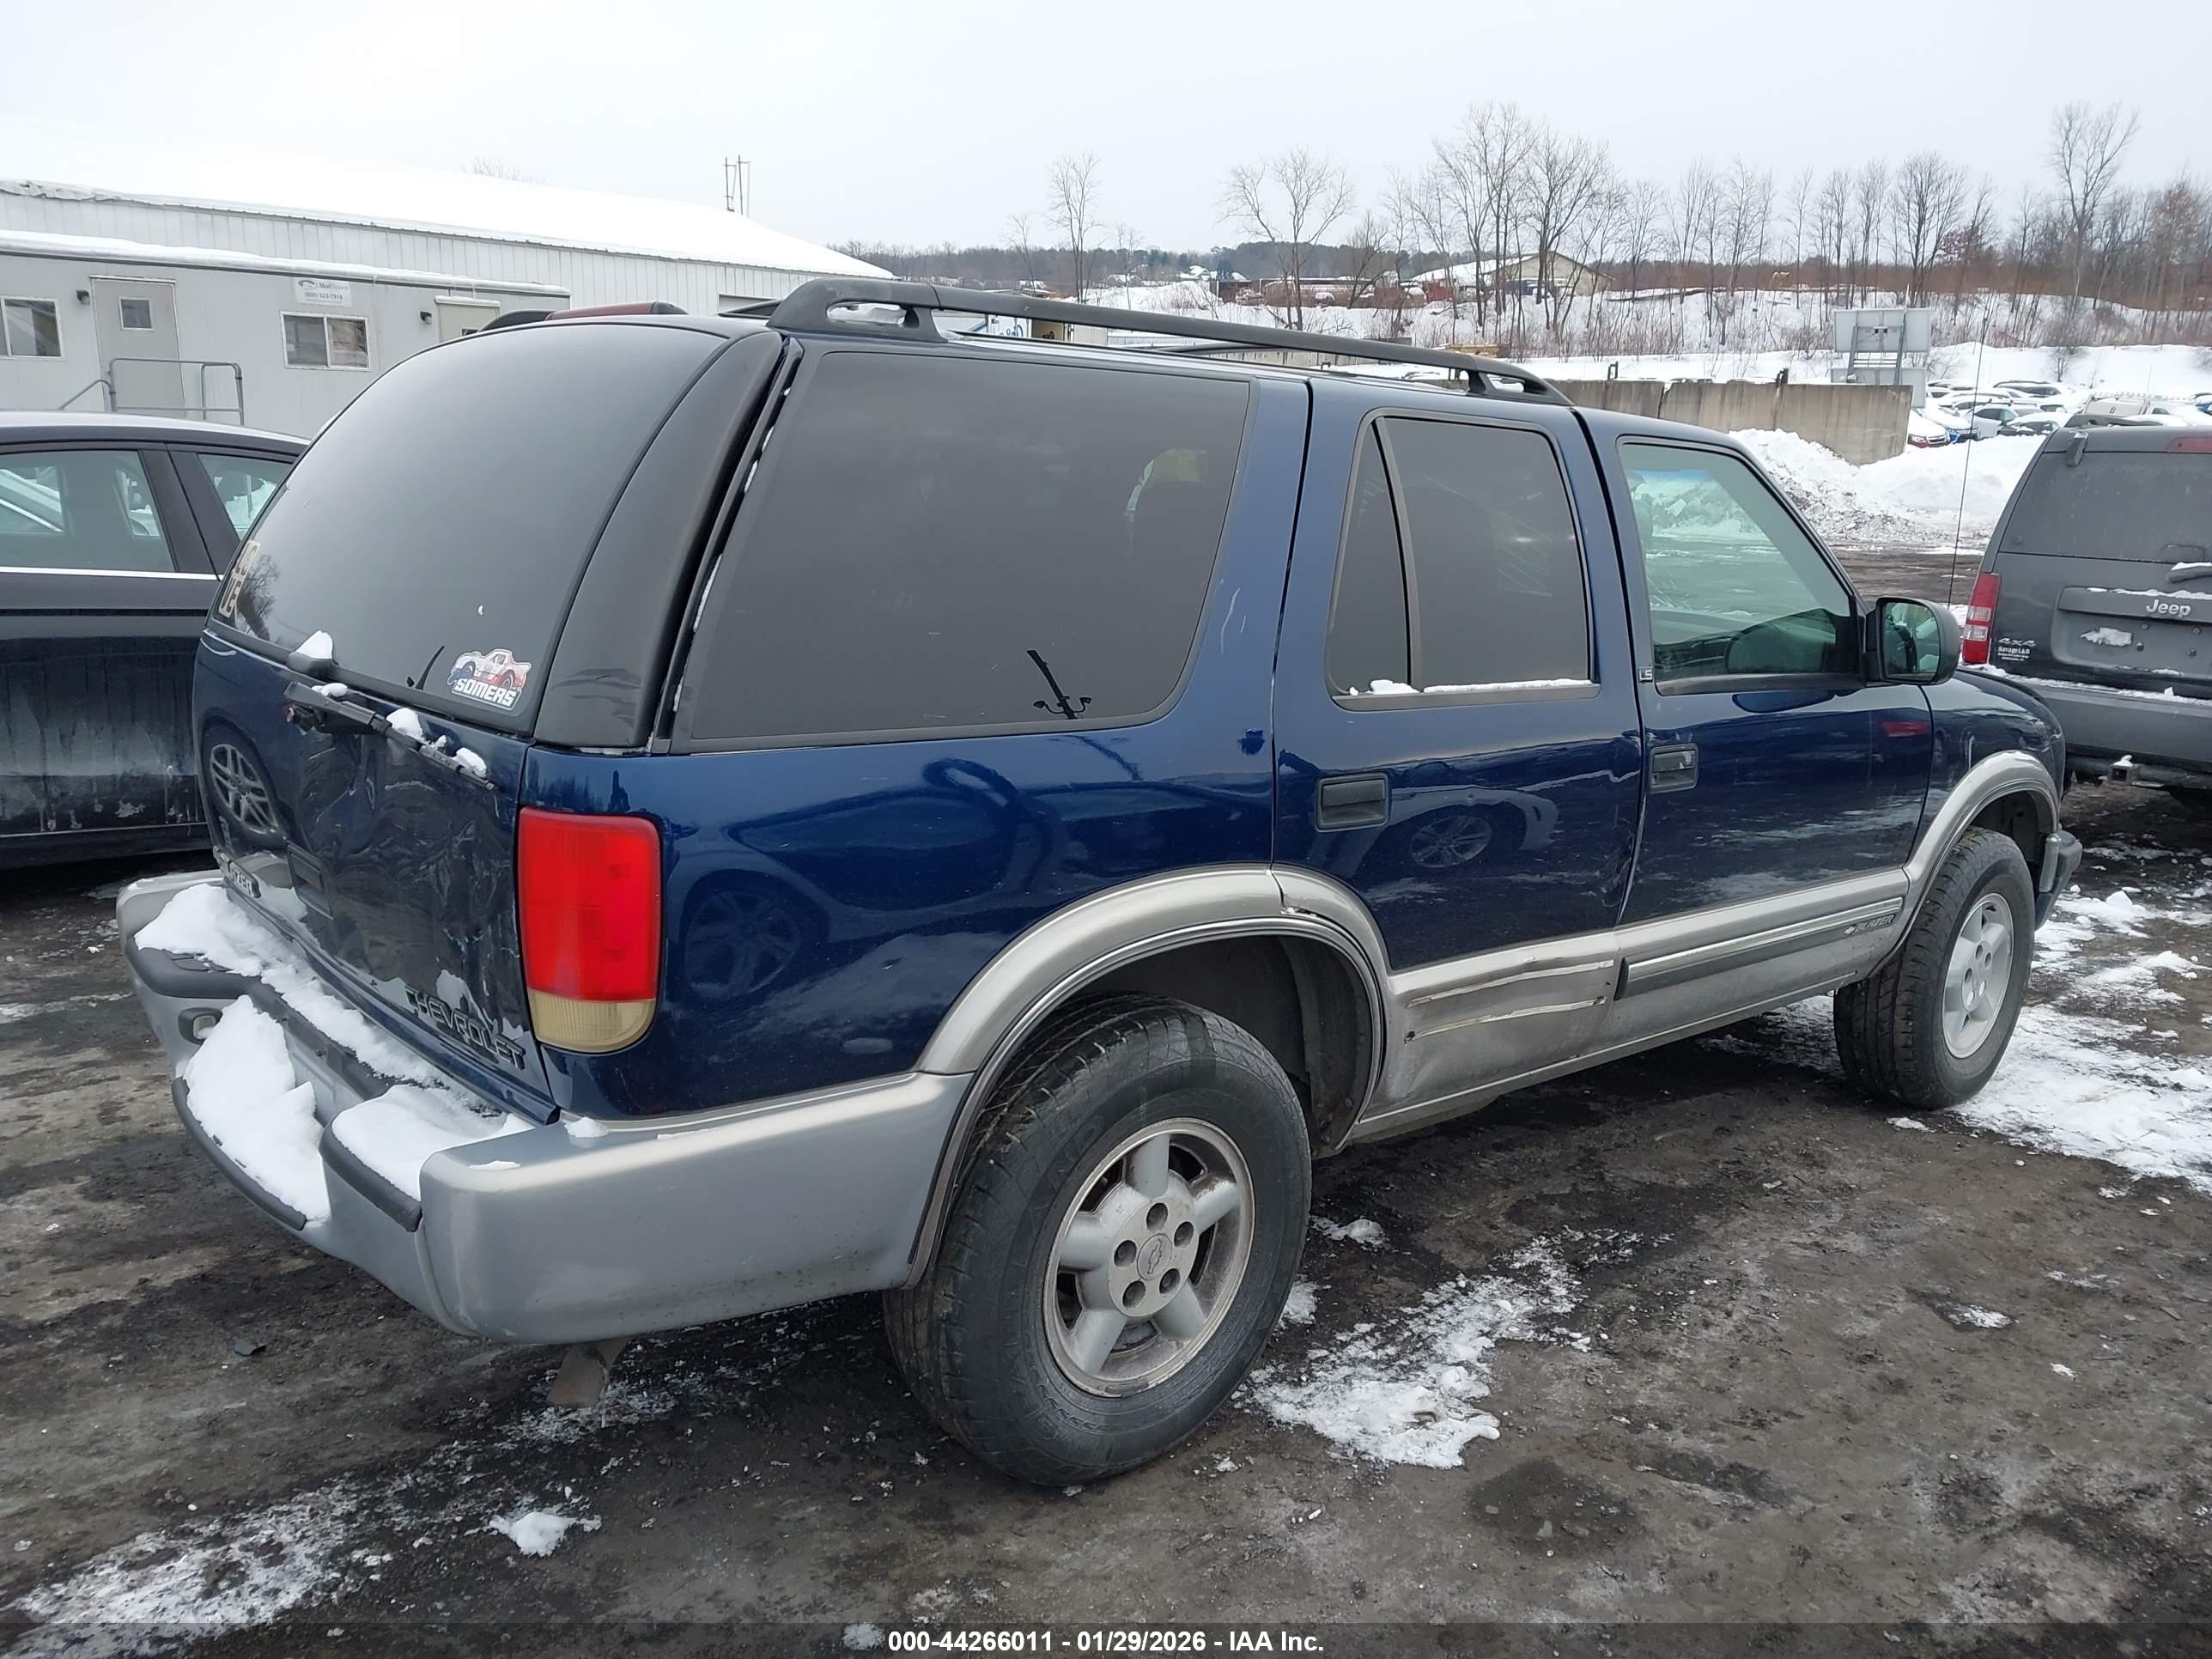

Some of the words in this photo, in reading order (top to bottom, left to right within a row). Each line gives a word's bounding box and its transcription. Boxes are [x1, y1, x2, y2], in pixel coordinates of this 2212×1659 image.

[2145, 599, 2191, 617] Jeep
[453, 678, 517, 707] SOMERS
[1854, 915, 1895, 933] BLAZER
[404, 984, 528, 1071] CHEVROLET
